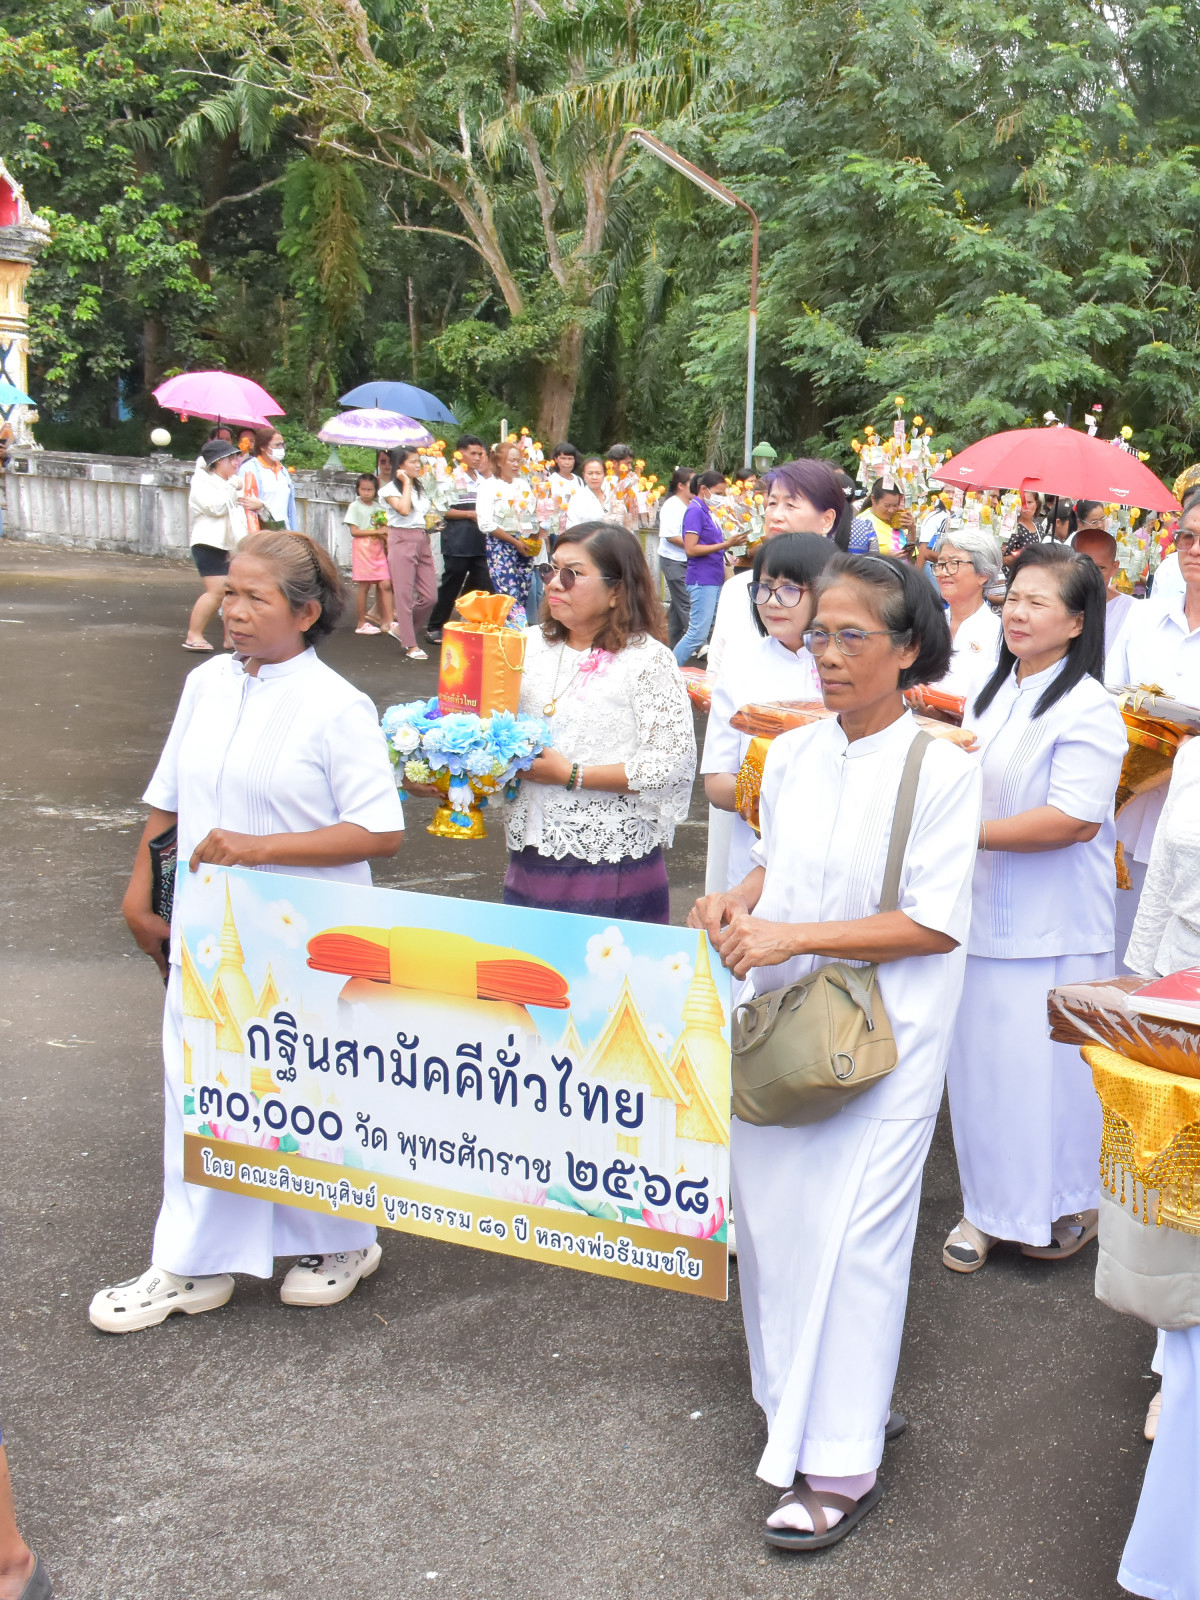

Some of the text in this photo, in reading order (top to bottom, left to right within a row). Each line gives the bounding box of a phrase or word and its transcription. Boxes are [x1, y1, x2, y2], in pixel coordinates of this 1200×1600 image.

[247, 1011, 644, 1128] กฐินสามัคคีทั่วไทย
[200, 1086, 709, 1214] ๓๐,๐๐๐ วัด พุทธศักราช ๒๕๖๘
[203, 1151, 700, 1277] โดย คณะศิษยานุศิษย์ บูชาธรรม ๘๑ ปี หลวงพ่อธัมมชโย
